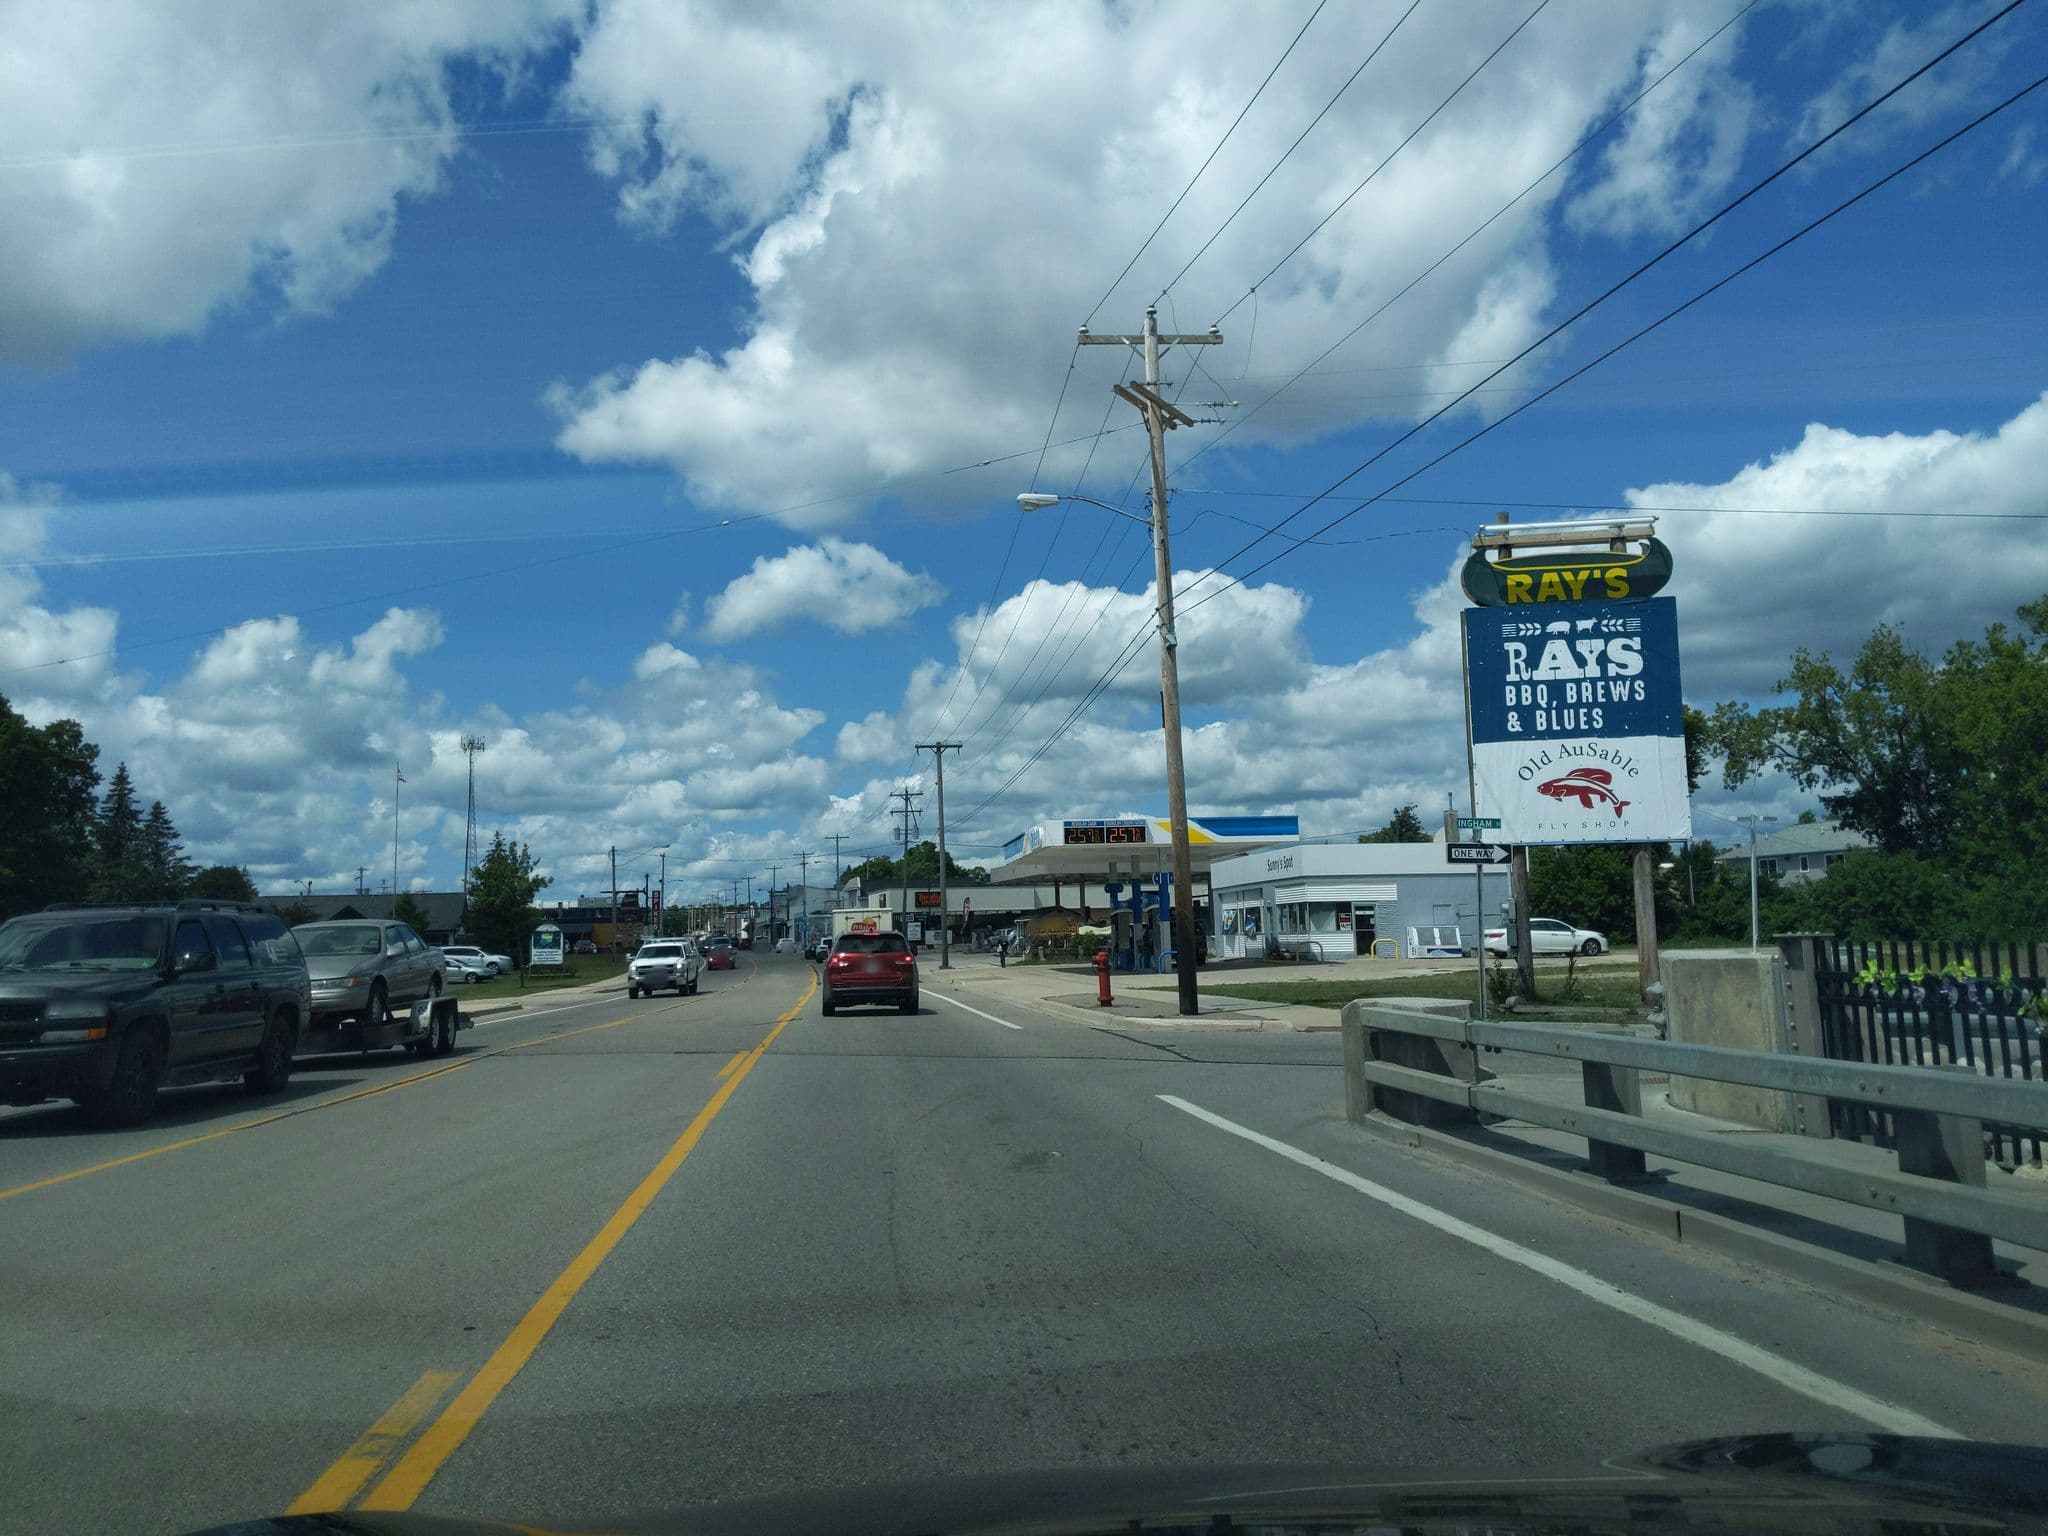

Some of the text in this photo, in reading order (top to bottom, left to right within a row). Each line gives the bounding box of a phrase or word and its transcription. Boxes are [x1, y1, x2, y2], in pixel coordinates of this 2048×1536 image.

[1506, 567, 1630, 604] RAY'S
[1503, 636, 1644, 682] RAYS
[1505, 680, 1646, 708] BBQ, BREWS
[1507, 708, 1604, 732] & BLUES
[1518, 742, 1639, 781] Old AuSable
[1458, 819, 1492, 828] INGHAM
[1581, 821, 1630, 829] SHOP
[1454, 849, 1494, 858] ONE WAY
